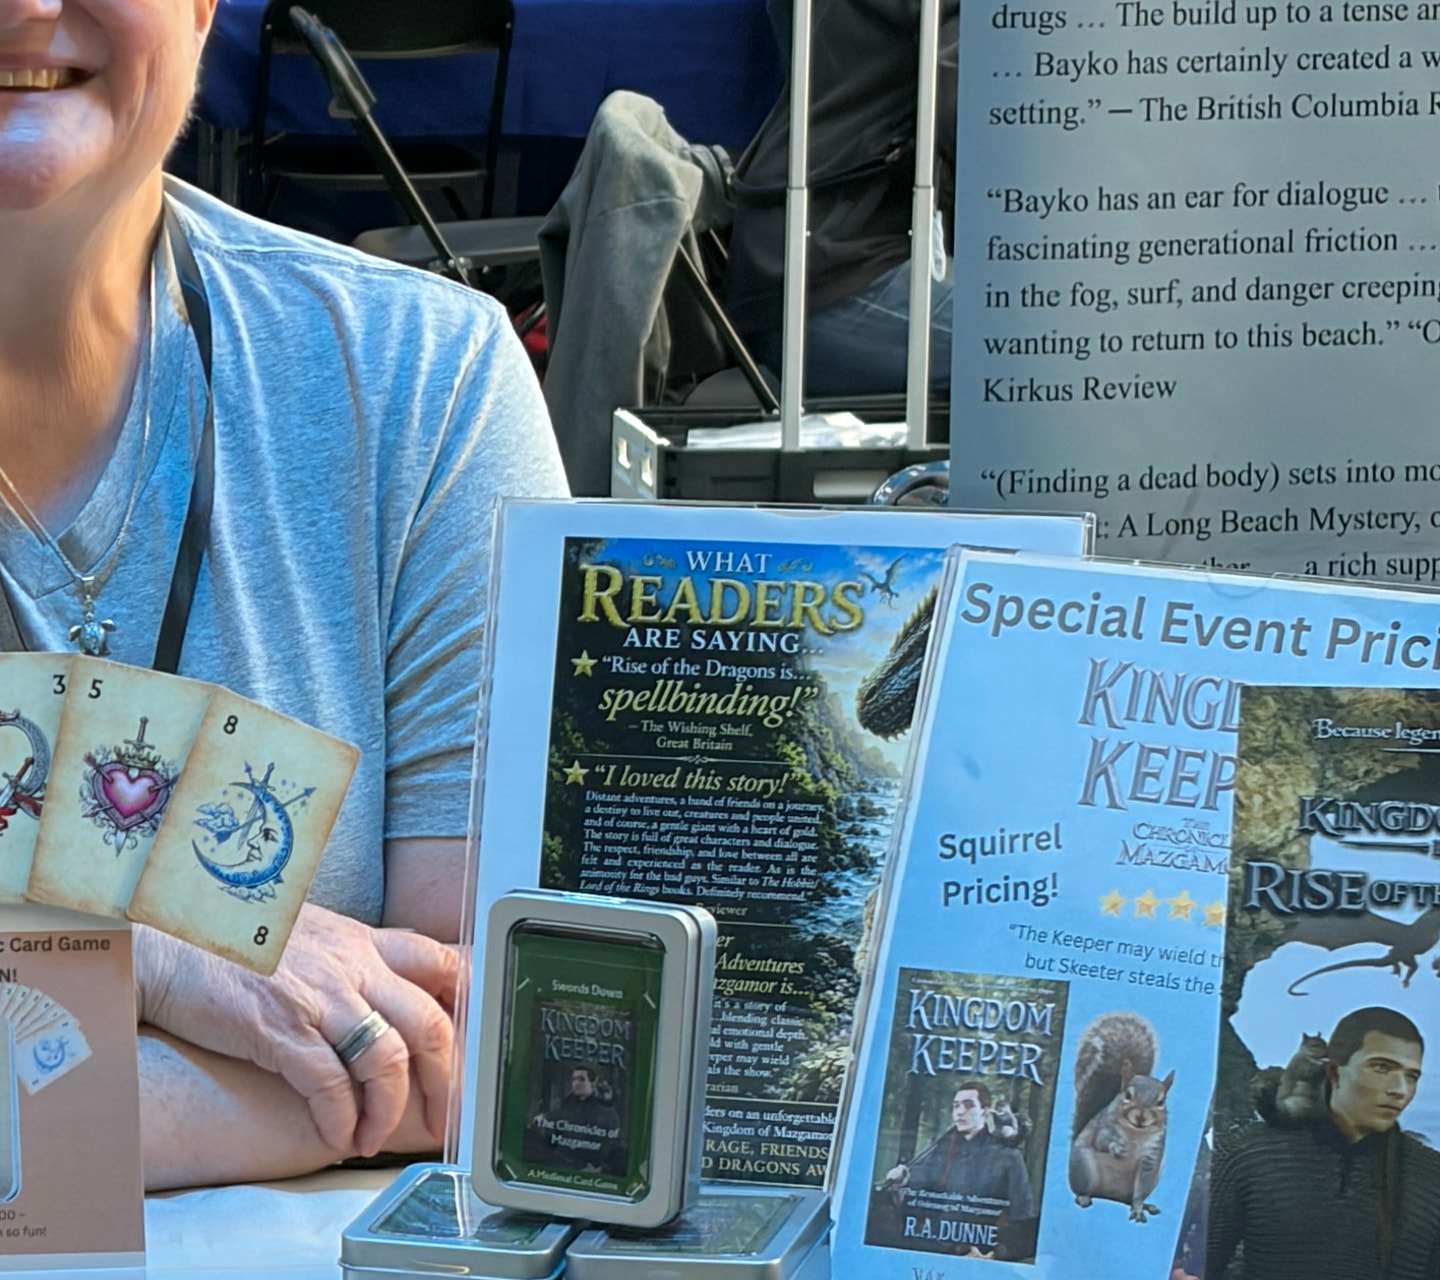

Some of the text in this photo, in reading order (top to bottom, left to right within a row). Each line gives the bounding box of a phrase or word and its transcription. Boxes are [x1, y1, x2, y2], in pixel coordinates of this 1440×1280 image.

[1139, 91, 1419, 122] The British Columbia
[984, 374, 1176, 402] Kirkus Review
[686, 550, 772, 573] WHAT
[577, 563, 864, 636] READERS
[960, 582, 1310, 656] Special Event
[623, 628, 824, 654] ARE SAYING...
[602, 656, 811, 682] “Rise of the Dragons is...
[52, 675, 66, 694] 3
[88, 679, 103, 699] 5
[598, 680, 818, 728] spellbinding!”
[223, 715, 238, 734] 8
[641, 720, 664, 733] The
[668, 722, 716, 737] Wishing
[1314, 718, 1391, 739] Because
[656, 736, 733, 750] Great Britain
[594, 763, 801, 798] “I loved this story!”
[939, 824, 1062, 863] Squirrel
[942, 872, 1059, 907] Pricing!
[1244, 861, 1365, 913] RISE
[10, 935, 52, 953] Card
[58, 936, 110, 951] Game
[254, 926, 269, 945] 8
[1052, 928, 1113, 953] Keeper
[1118, 941, 1153, 960] may
[1158, 945, 1204, 965] wield
[1025, 953, 1213, 995] but Skeeter steals the
[906, 989, 1056, 1036] KINGDOM
[911, 1034, 1044, 1087] KEEPER
[7, 1228, 18, 1237] so
[23, 1227, 46, 1237] fun!
[938, 1221, 999, 1246] DUNNE
